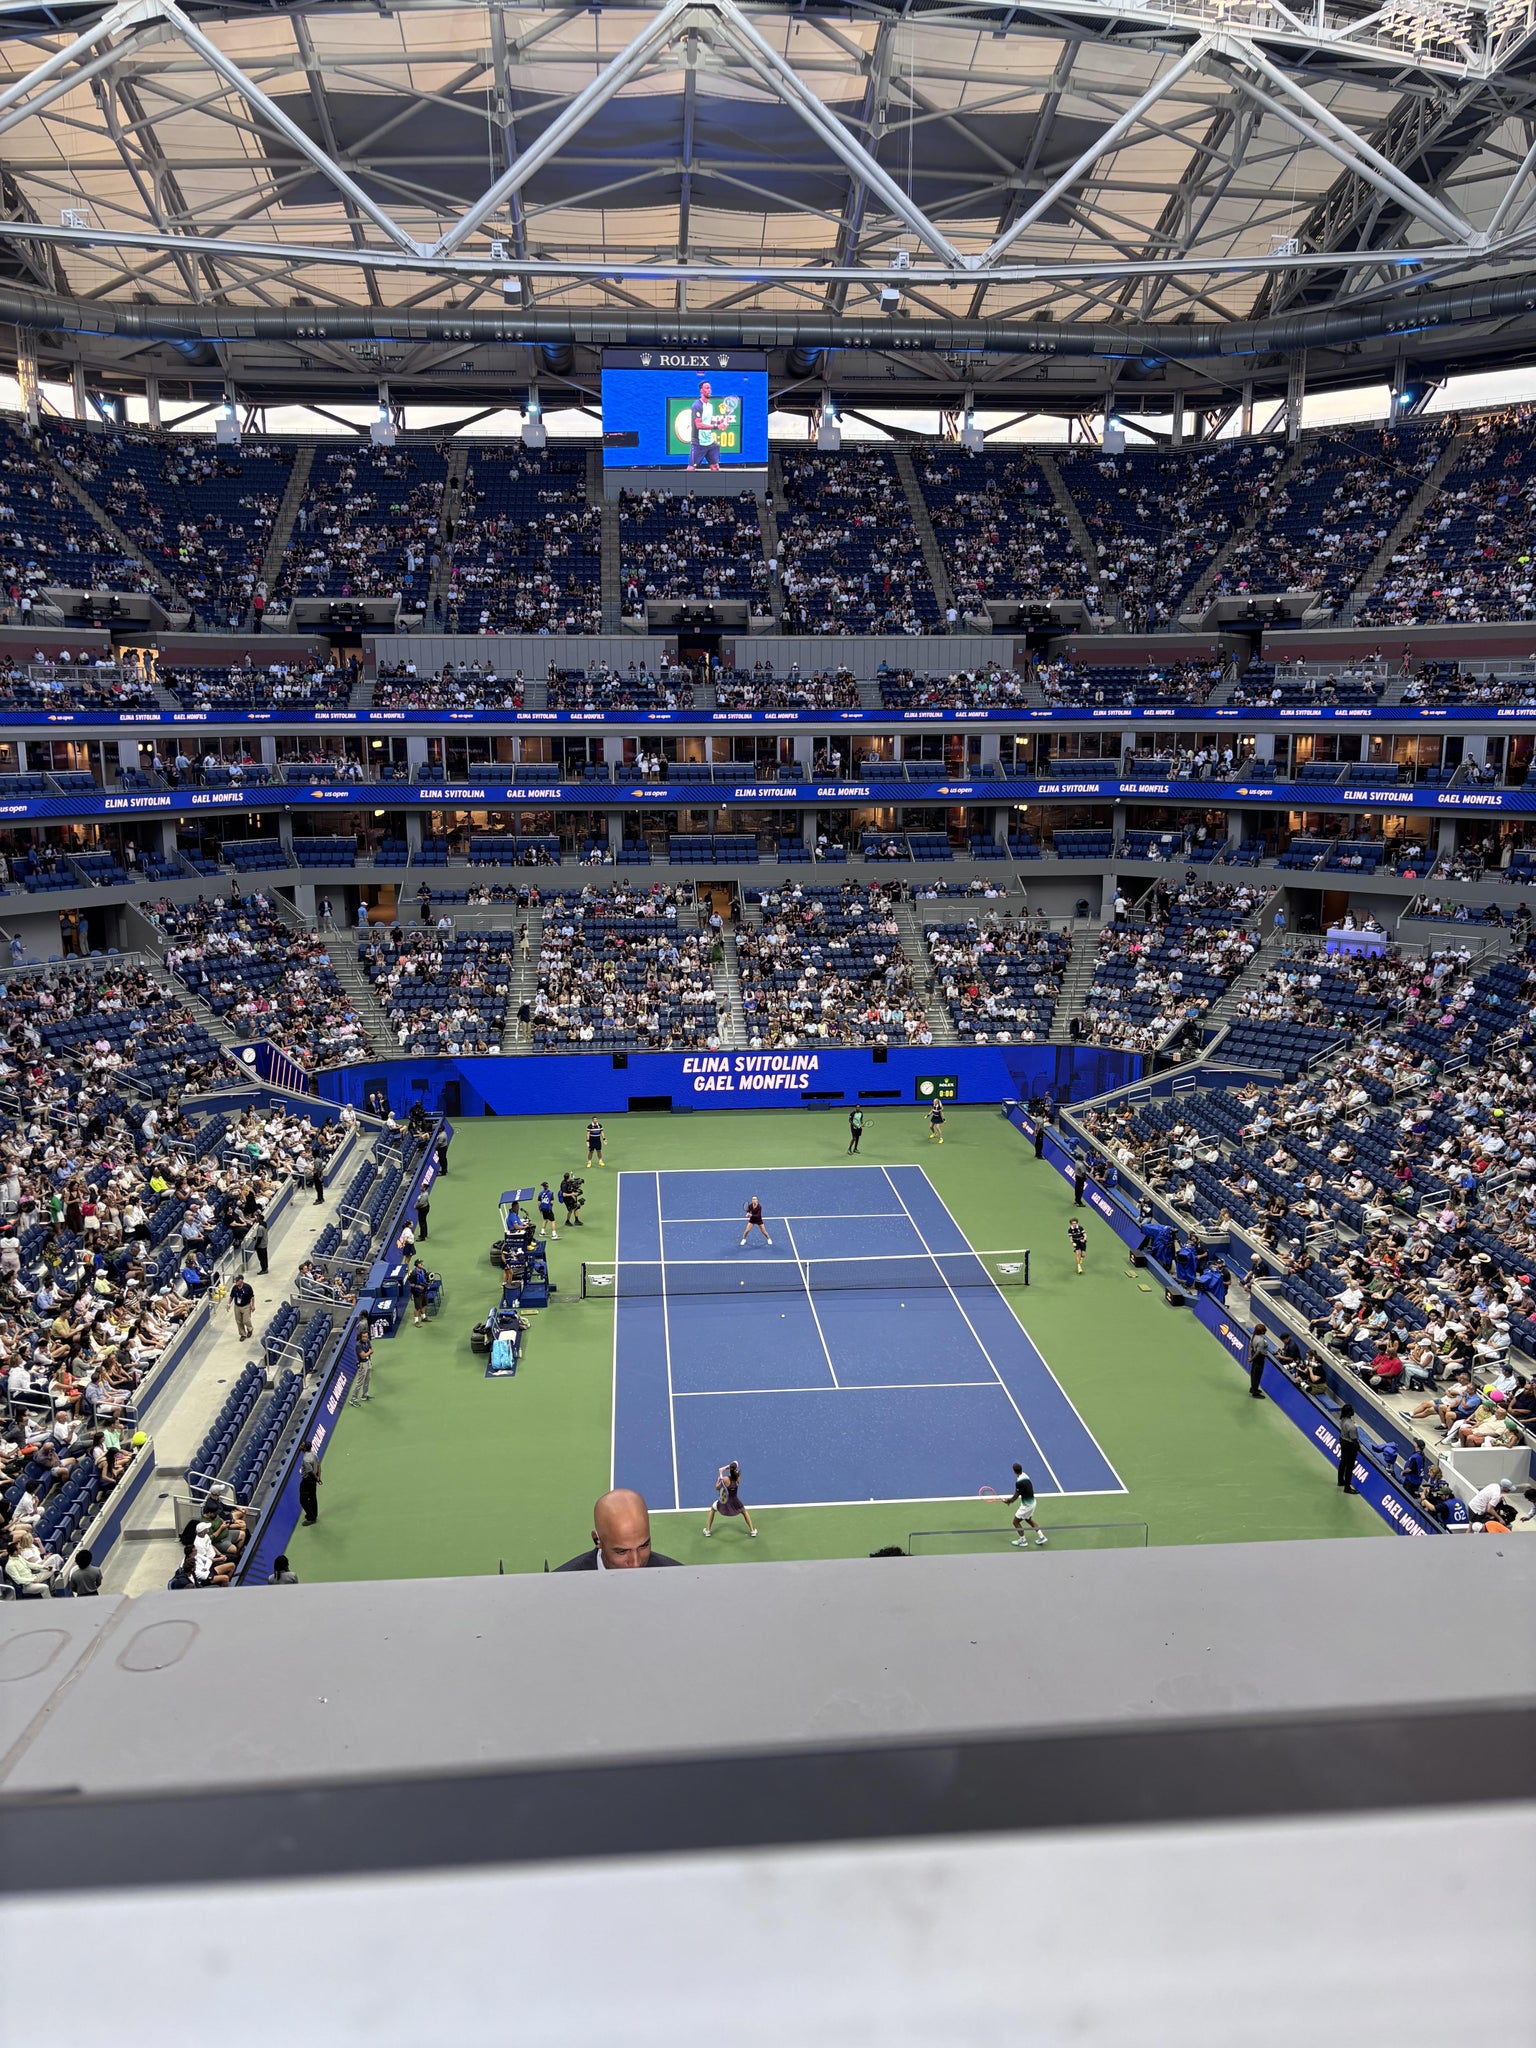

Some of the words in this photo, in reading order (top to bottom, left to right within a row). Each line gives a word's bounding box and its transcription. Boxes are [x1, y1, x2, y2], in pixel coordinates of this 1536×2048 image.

[660, 355, 711, 367] ROLEX
[1061, 784, 1099, 792] SVITOLINA
[1120, 784, 1137, 792] GAEL
[1139, 785, 1169, 793] MONFILS
[192, 795, 210, 803] GAEL
[212, 793, 243, 802] MONFILS
[445, 790, 485, 798] SVITOLINA
[507, 790, 526, 798] GAEL
[1344, 791, 1368, 800] ELINA
[1370, 792, 1413, 801] SVITOLINA
[1438, 794, 1460, 803] GAEL
[1462, 795, 1502, 804] MONFILS
[105, 799, 128, 808] ELINA
[130, 797, 170, 807] SVITOLINA
[683, 1057, 729, 1073] ELINA
[734, 1055, 819, 1072] SVITOLINA
[694, 1076, 734, 1091] GAEL
[739, 1074, 809, 1090] MONFILS
[1315, 1425, 1336, 1449] ELINA
[1381, 1495, 1402, 1519] GAEL
